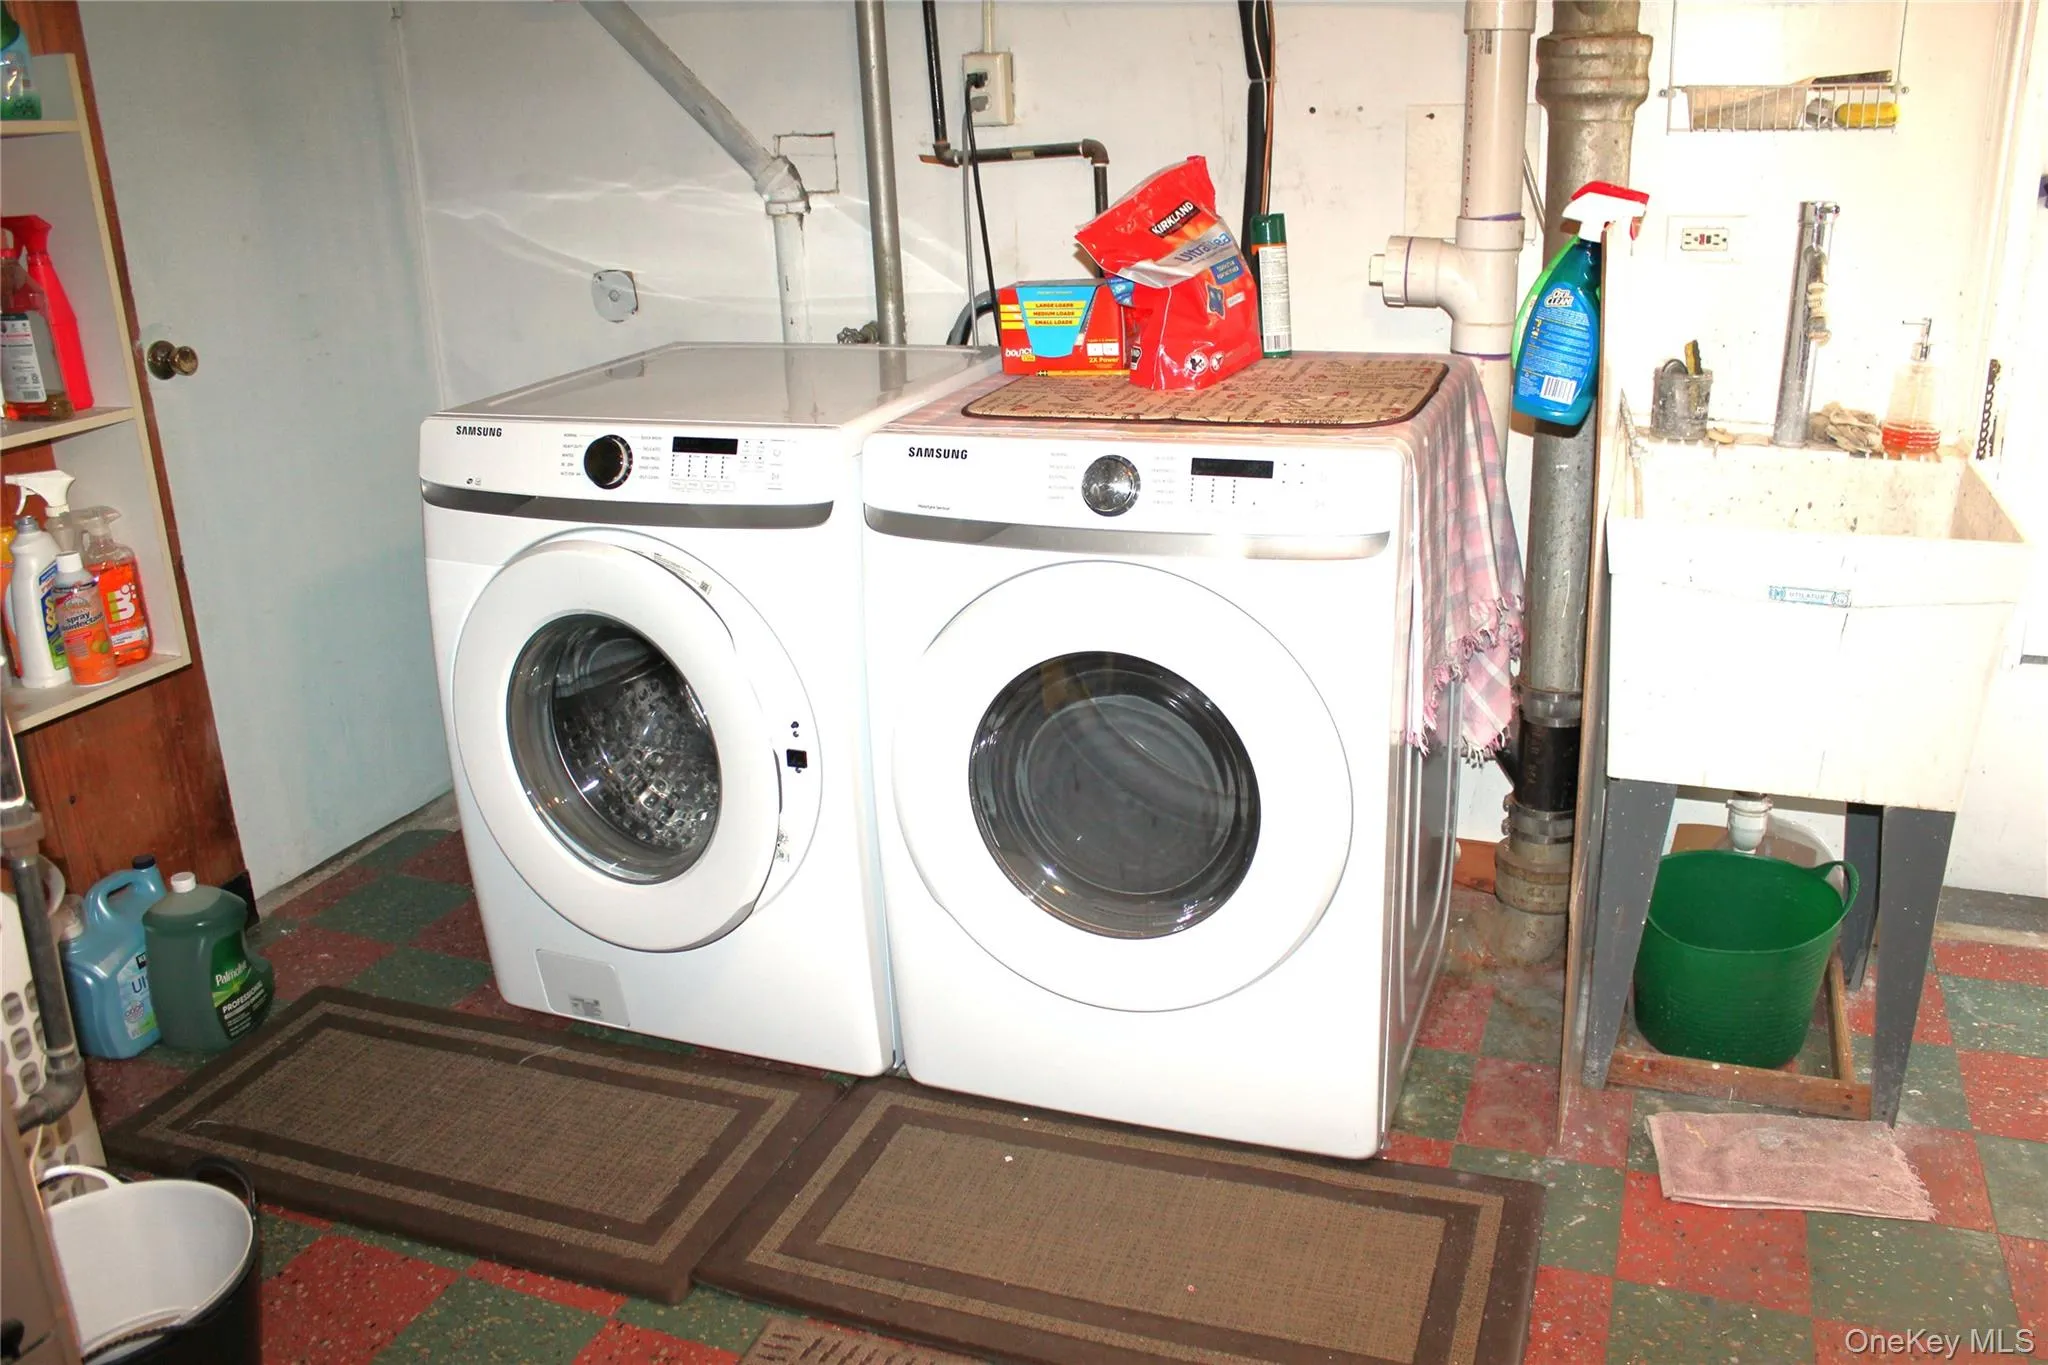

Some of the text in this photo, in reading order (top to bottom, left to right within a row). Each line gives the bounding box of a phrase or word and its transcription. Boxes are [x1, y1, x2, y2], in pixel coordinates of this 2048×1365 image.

[1151, 201, 1194, 236] KIRKLAND
[1175, 241, 1211, 263] Ultra
[456, 425, 503, 438] SAMSUNG
[908, 446, 968, 460] SAMSUNG
[66, 612, 90, 625] spray
